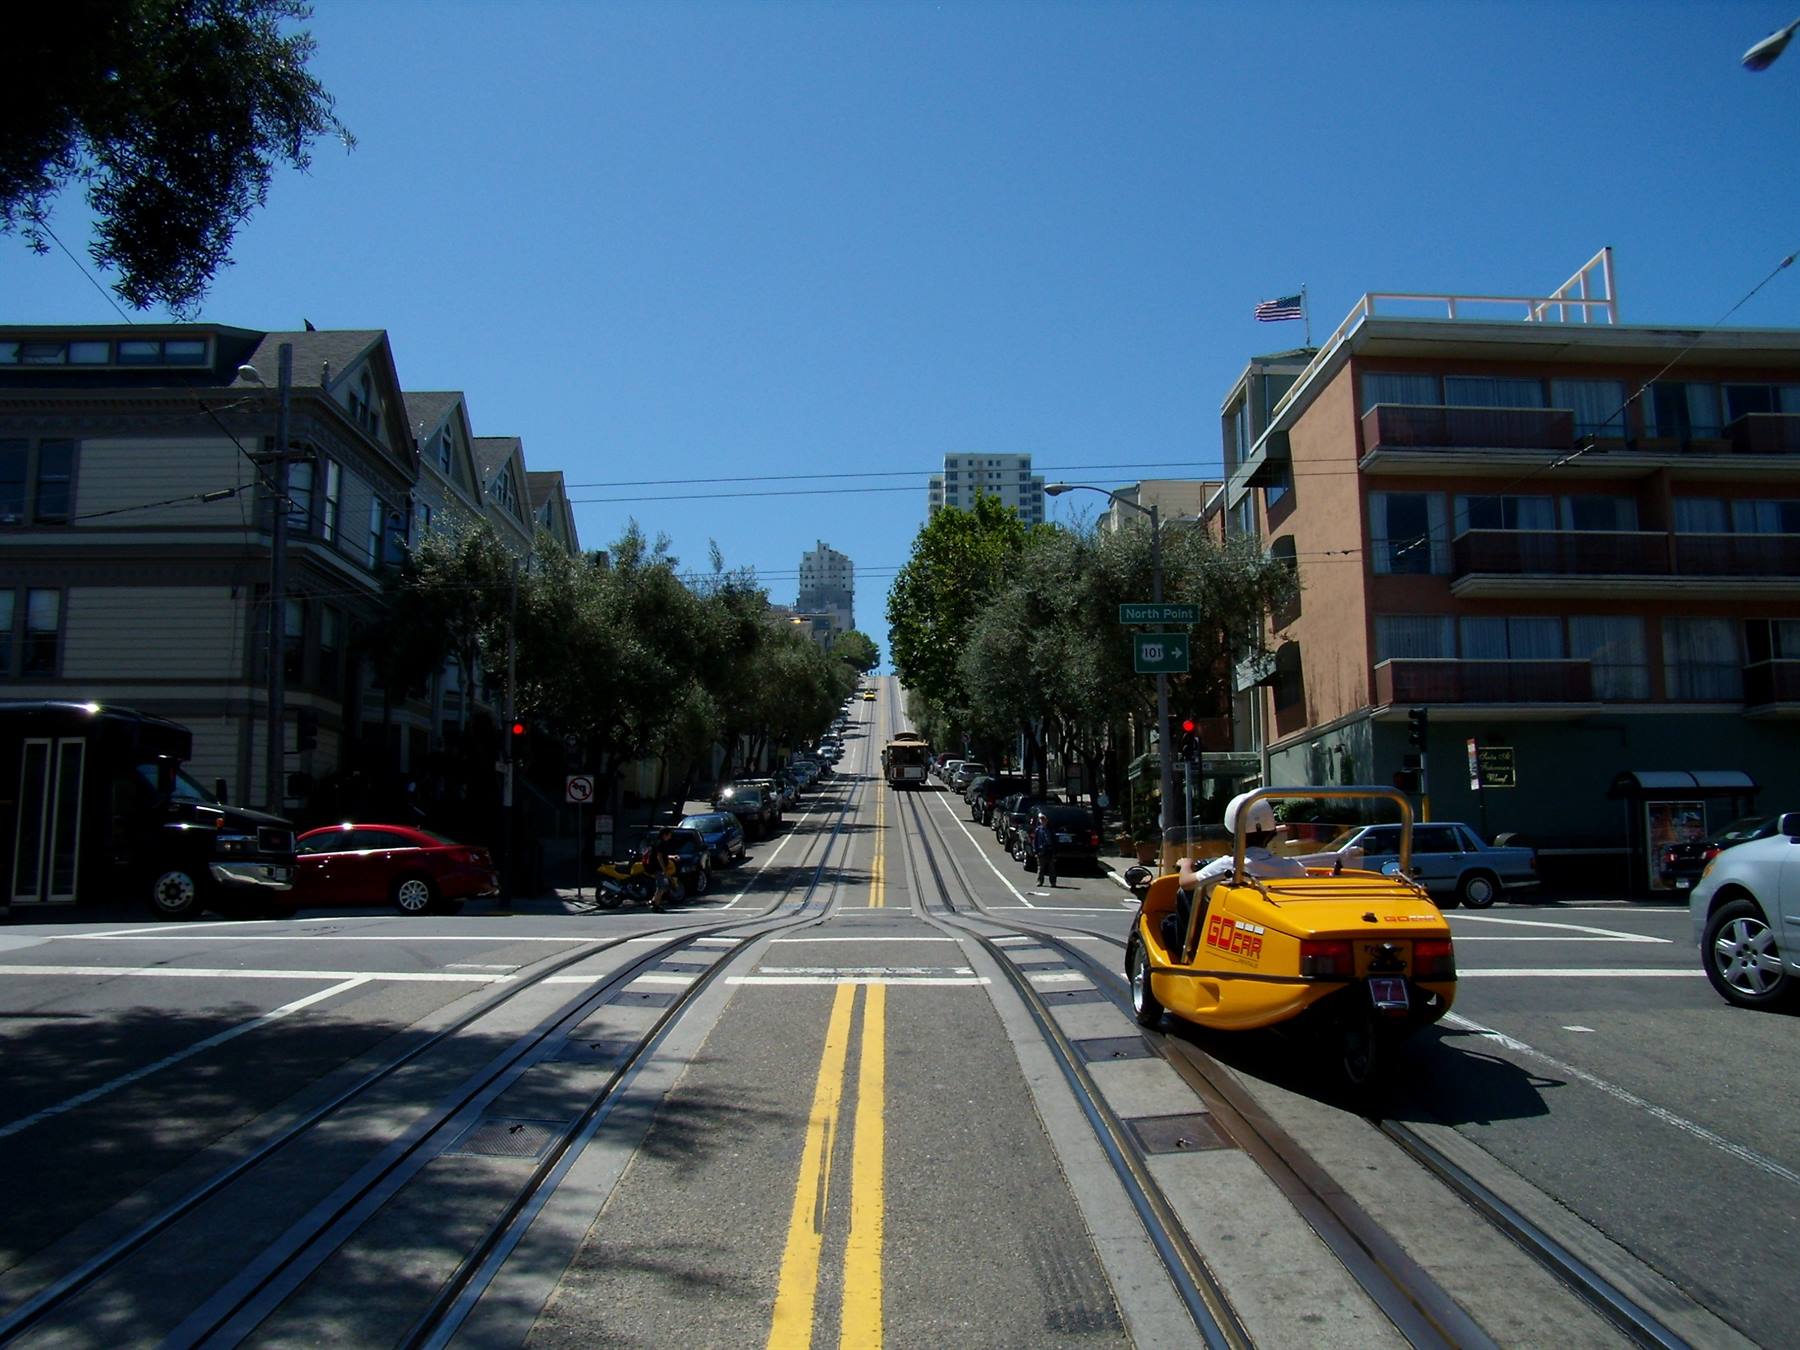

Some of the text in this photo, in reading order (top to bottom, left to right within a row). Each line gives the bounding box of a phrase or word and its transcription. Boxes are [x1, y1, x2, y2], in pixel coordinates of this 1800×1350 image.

[1126, 608, 1193, 619] North Point
[1144, 647, 1161, 658] 101
